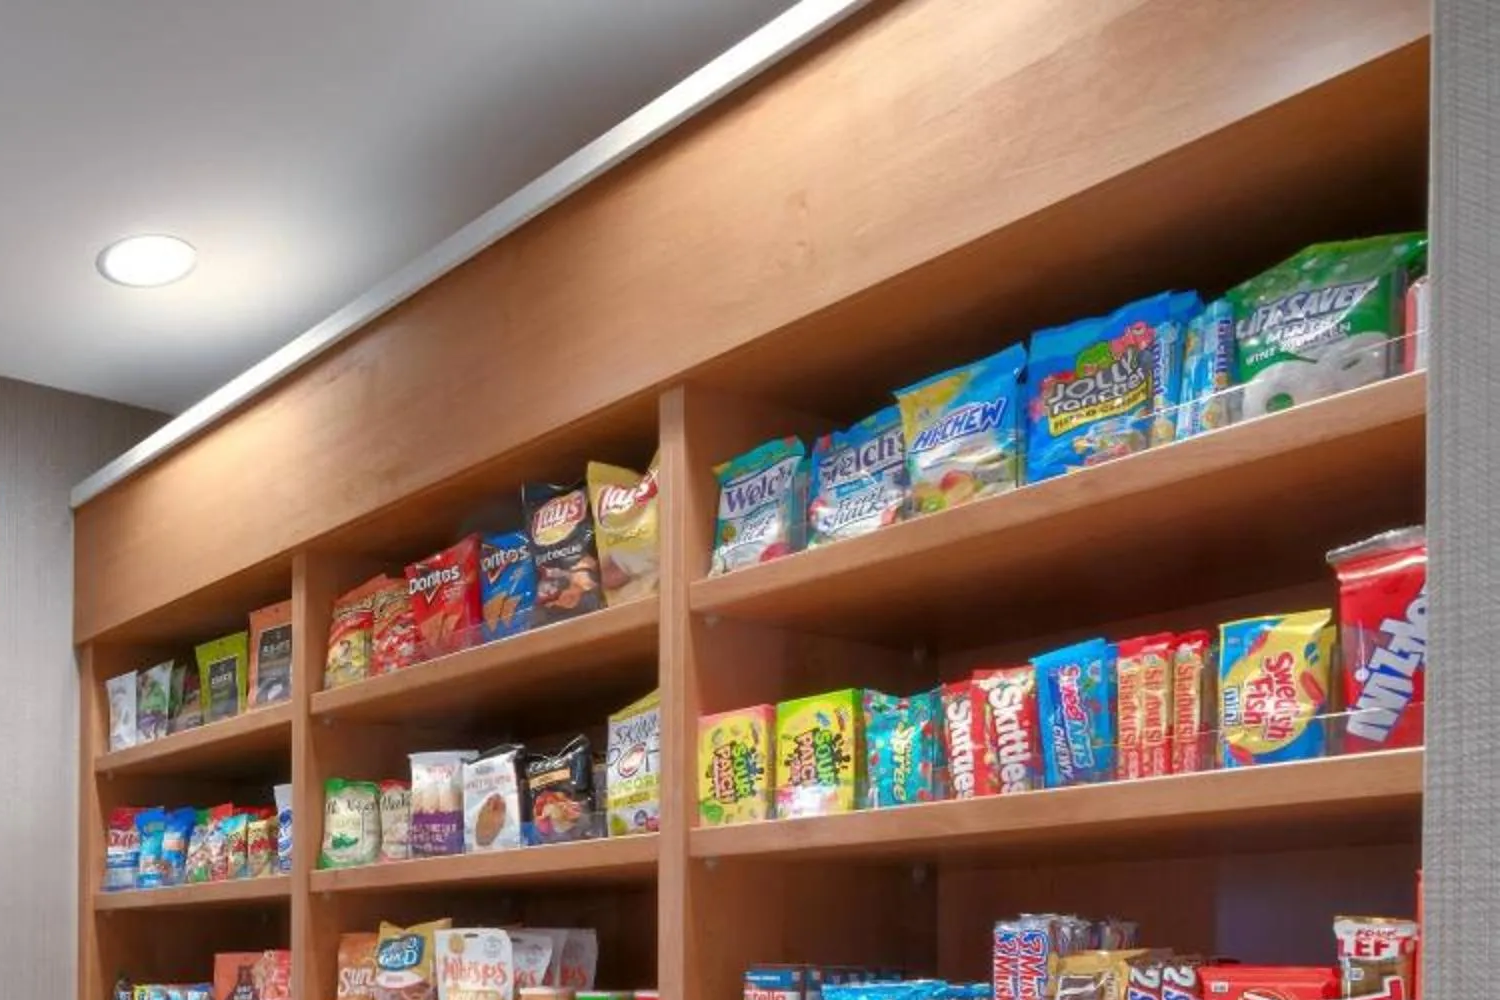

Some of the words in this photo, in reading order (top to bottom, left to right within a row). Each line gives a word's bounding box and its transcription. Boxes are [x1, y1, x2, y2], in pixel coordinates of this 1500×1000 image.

[1048, 348, 1133, 403] JOLLY
[481, 545, 531, 572] oritos
[409, 564, 460, 594] Doritos
[1244, 676, 1273, 726] Fish
[1264, 652, 1295, 740] Swedish
[1131, 967, 1159, 988] 2
[1164, 965, 1196, 987] 2
